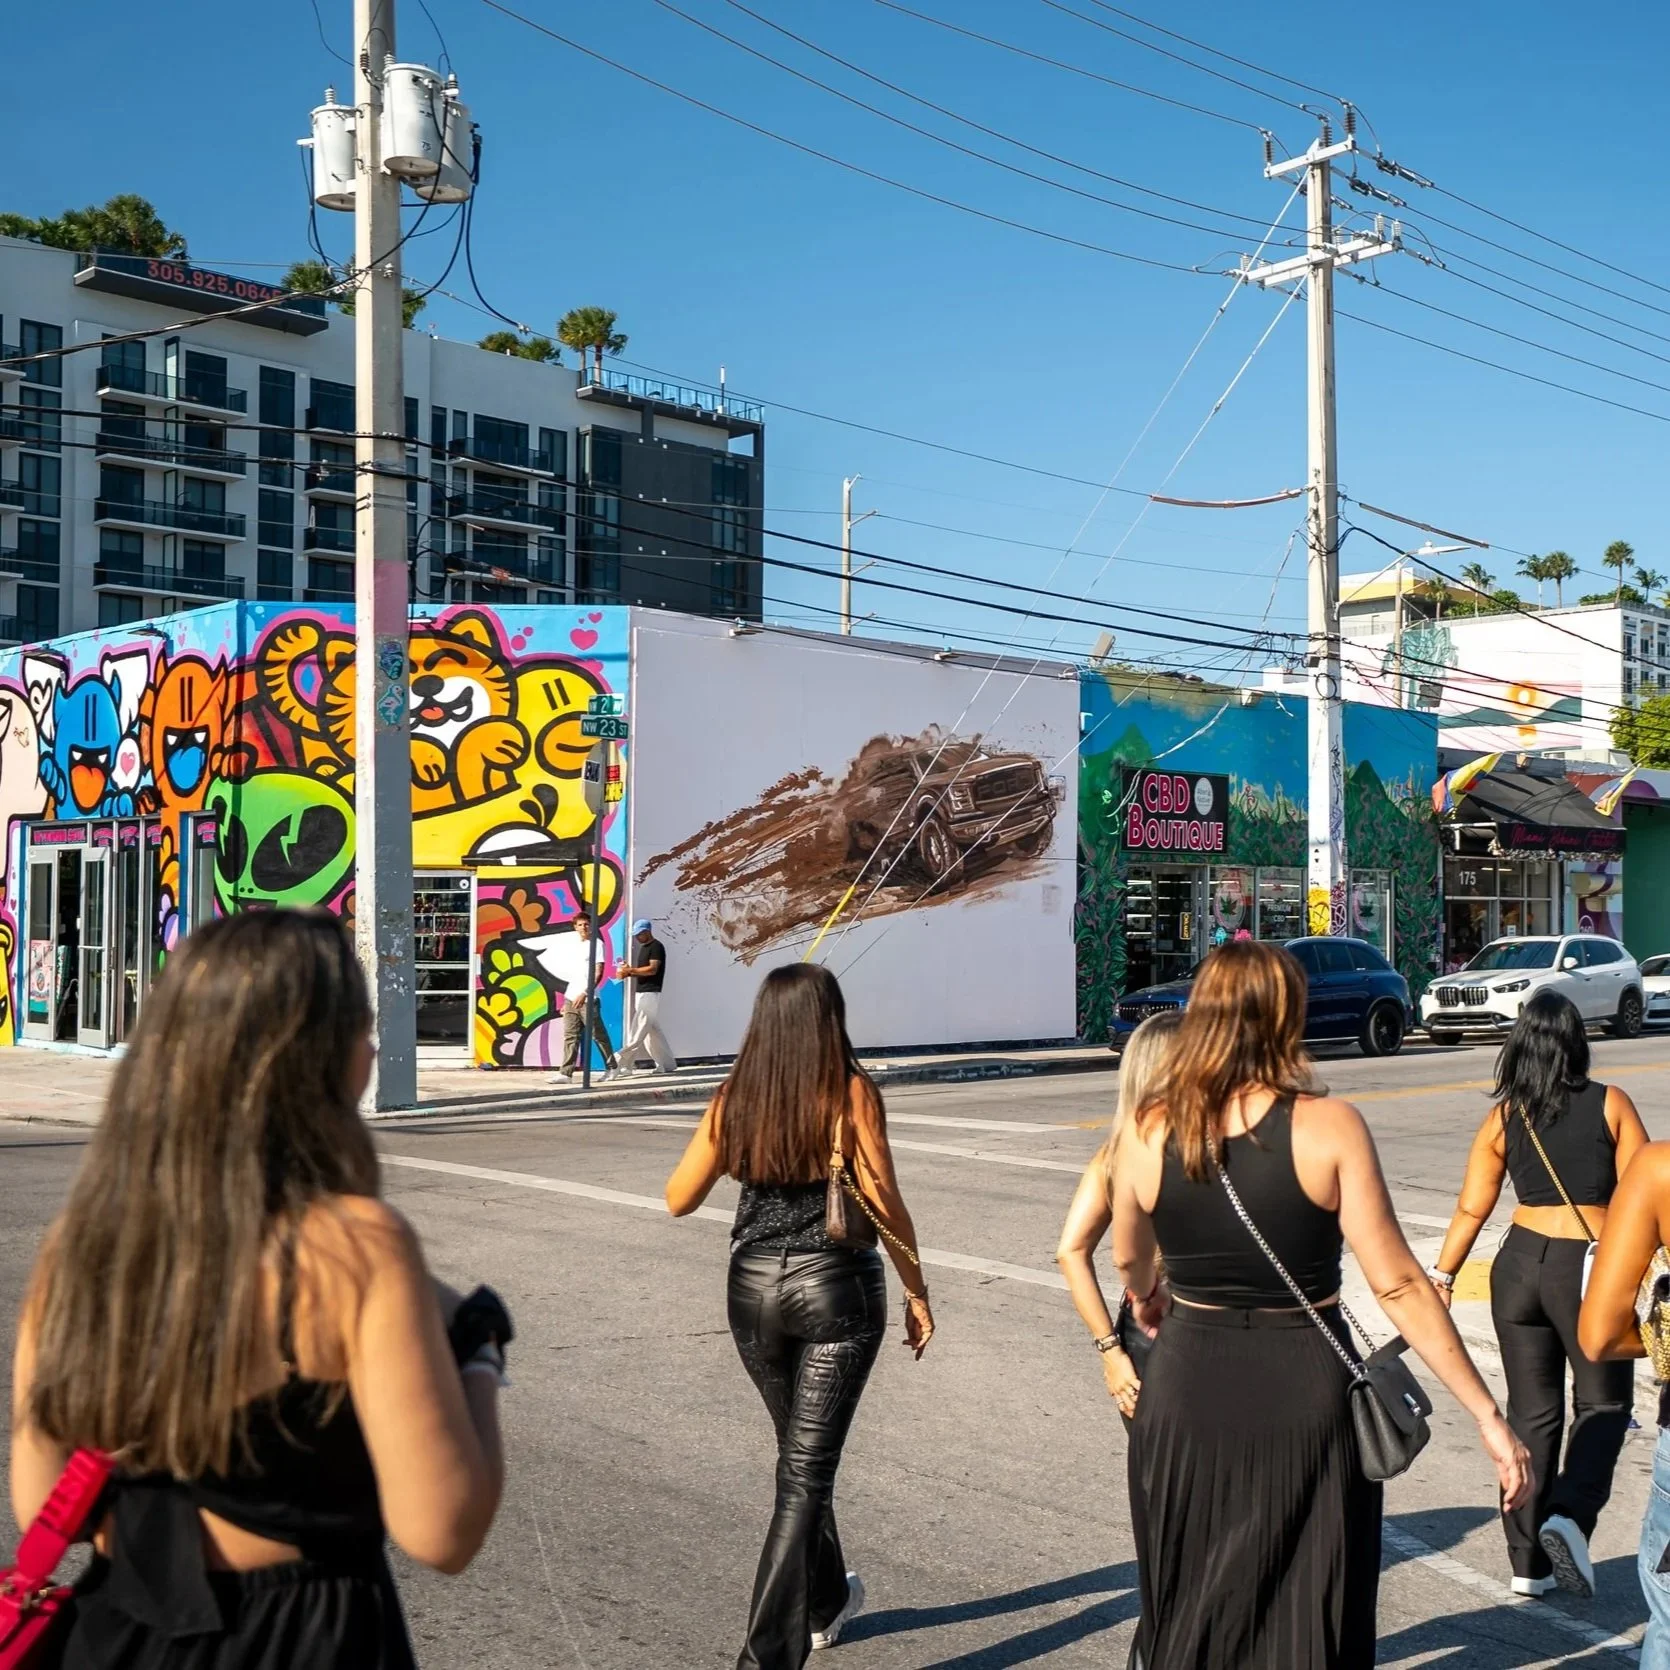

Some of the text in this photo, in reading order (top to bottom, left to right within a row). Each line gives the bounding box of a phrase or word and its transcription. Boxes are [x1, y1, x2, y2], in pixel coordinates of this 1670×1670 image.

[583, 719, 627, 736] NW 23 ST
[1143, 773, 1190, 813] CBD
[1459, 871, 1476, 885] 175
